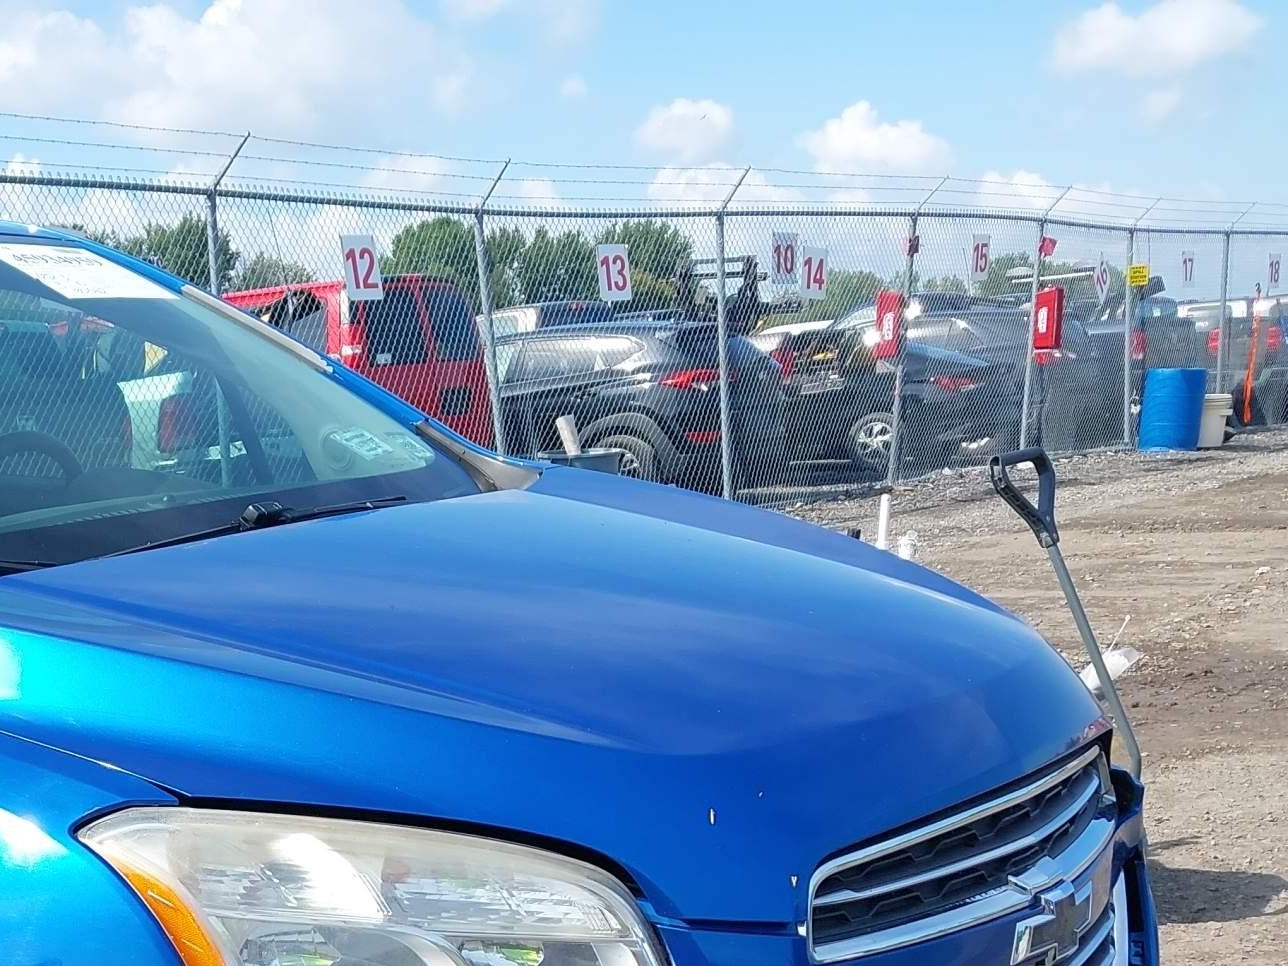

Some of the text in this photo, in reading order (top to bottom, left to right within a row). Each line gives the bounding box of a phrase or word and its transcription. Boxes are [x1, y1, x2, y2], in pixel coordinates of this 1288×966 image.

[345, 247, 379, 290] 12
[600, 255, 628, 292] 13
[773, 244, 795, 275] 10
[803, 256, 825, 290] 14
[973, 243, 989, 273] 15
[1182, 257, 1194, 282] 17
[1269, 260, 1280, 283] 18
[1096, 262, 1108, 293] 16
